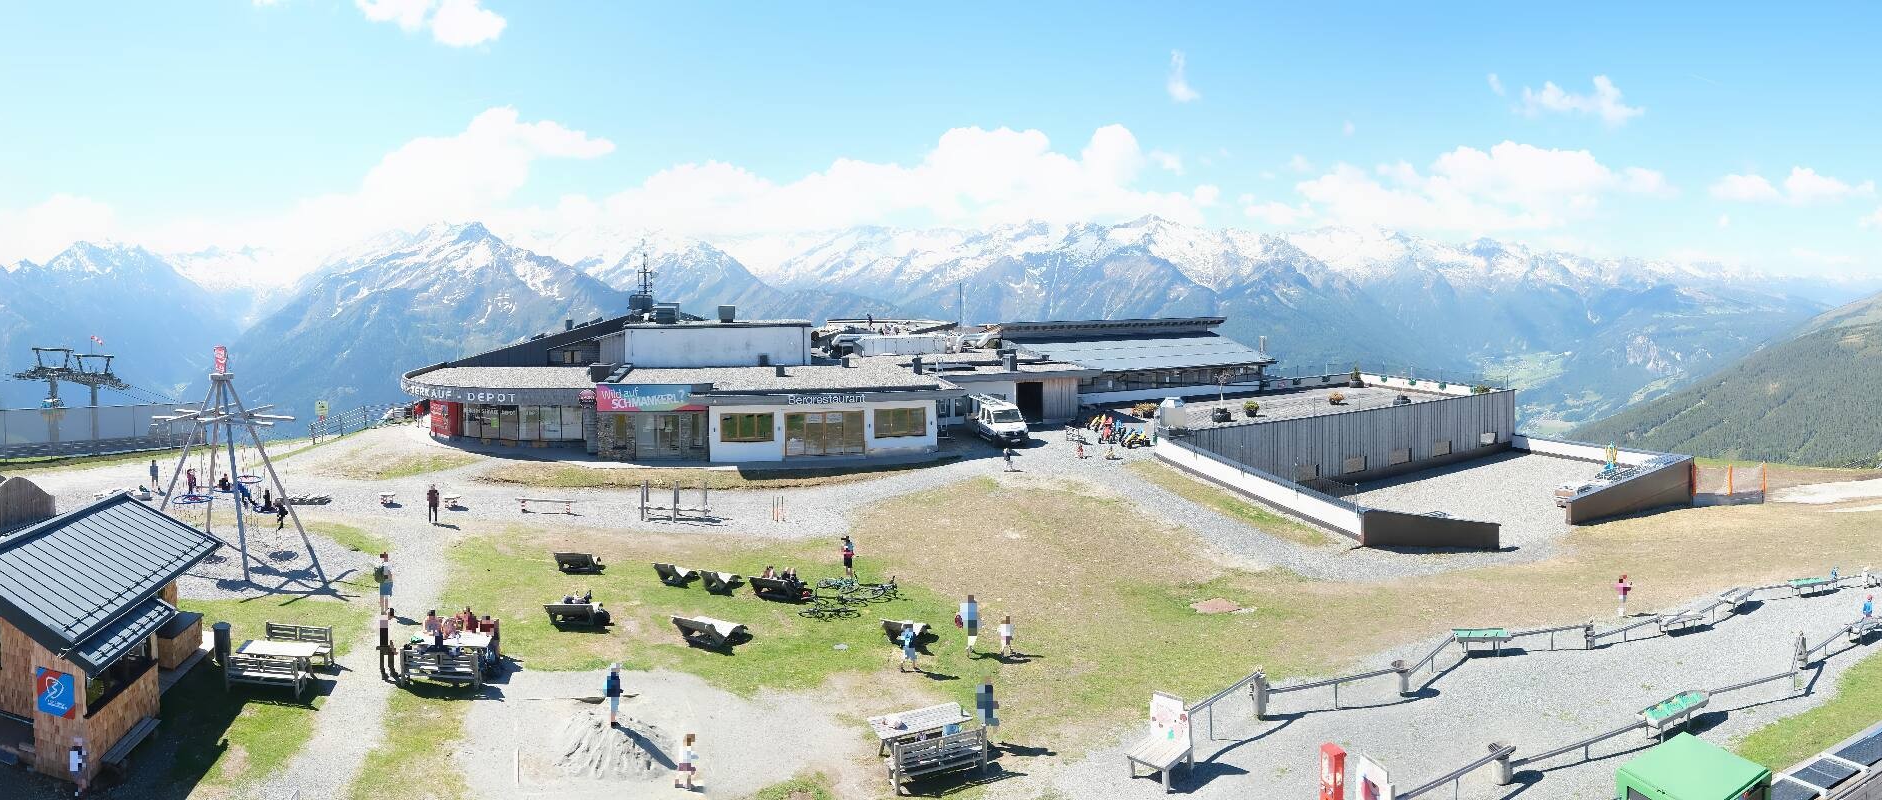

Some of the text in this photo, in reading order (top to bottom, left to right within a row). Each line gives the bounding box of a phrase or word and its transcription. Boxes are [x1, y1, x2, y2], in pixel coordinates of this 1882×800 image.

[467, 393, 516, 402] DEPOT
[601, 388, 622, 399] Wild
[624, 386, 639, 398] auf
[611, 389, 685, 409] SCHMANKERL?
[788, 393, 866, 407] Bergrestaurant
